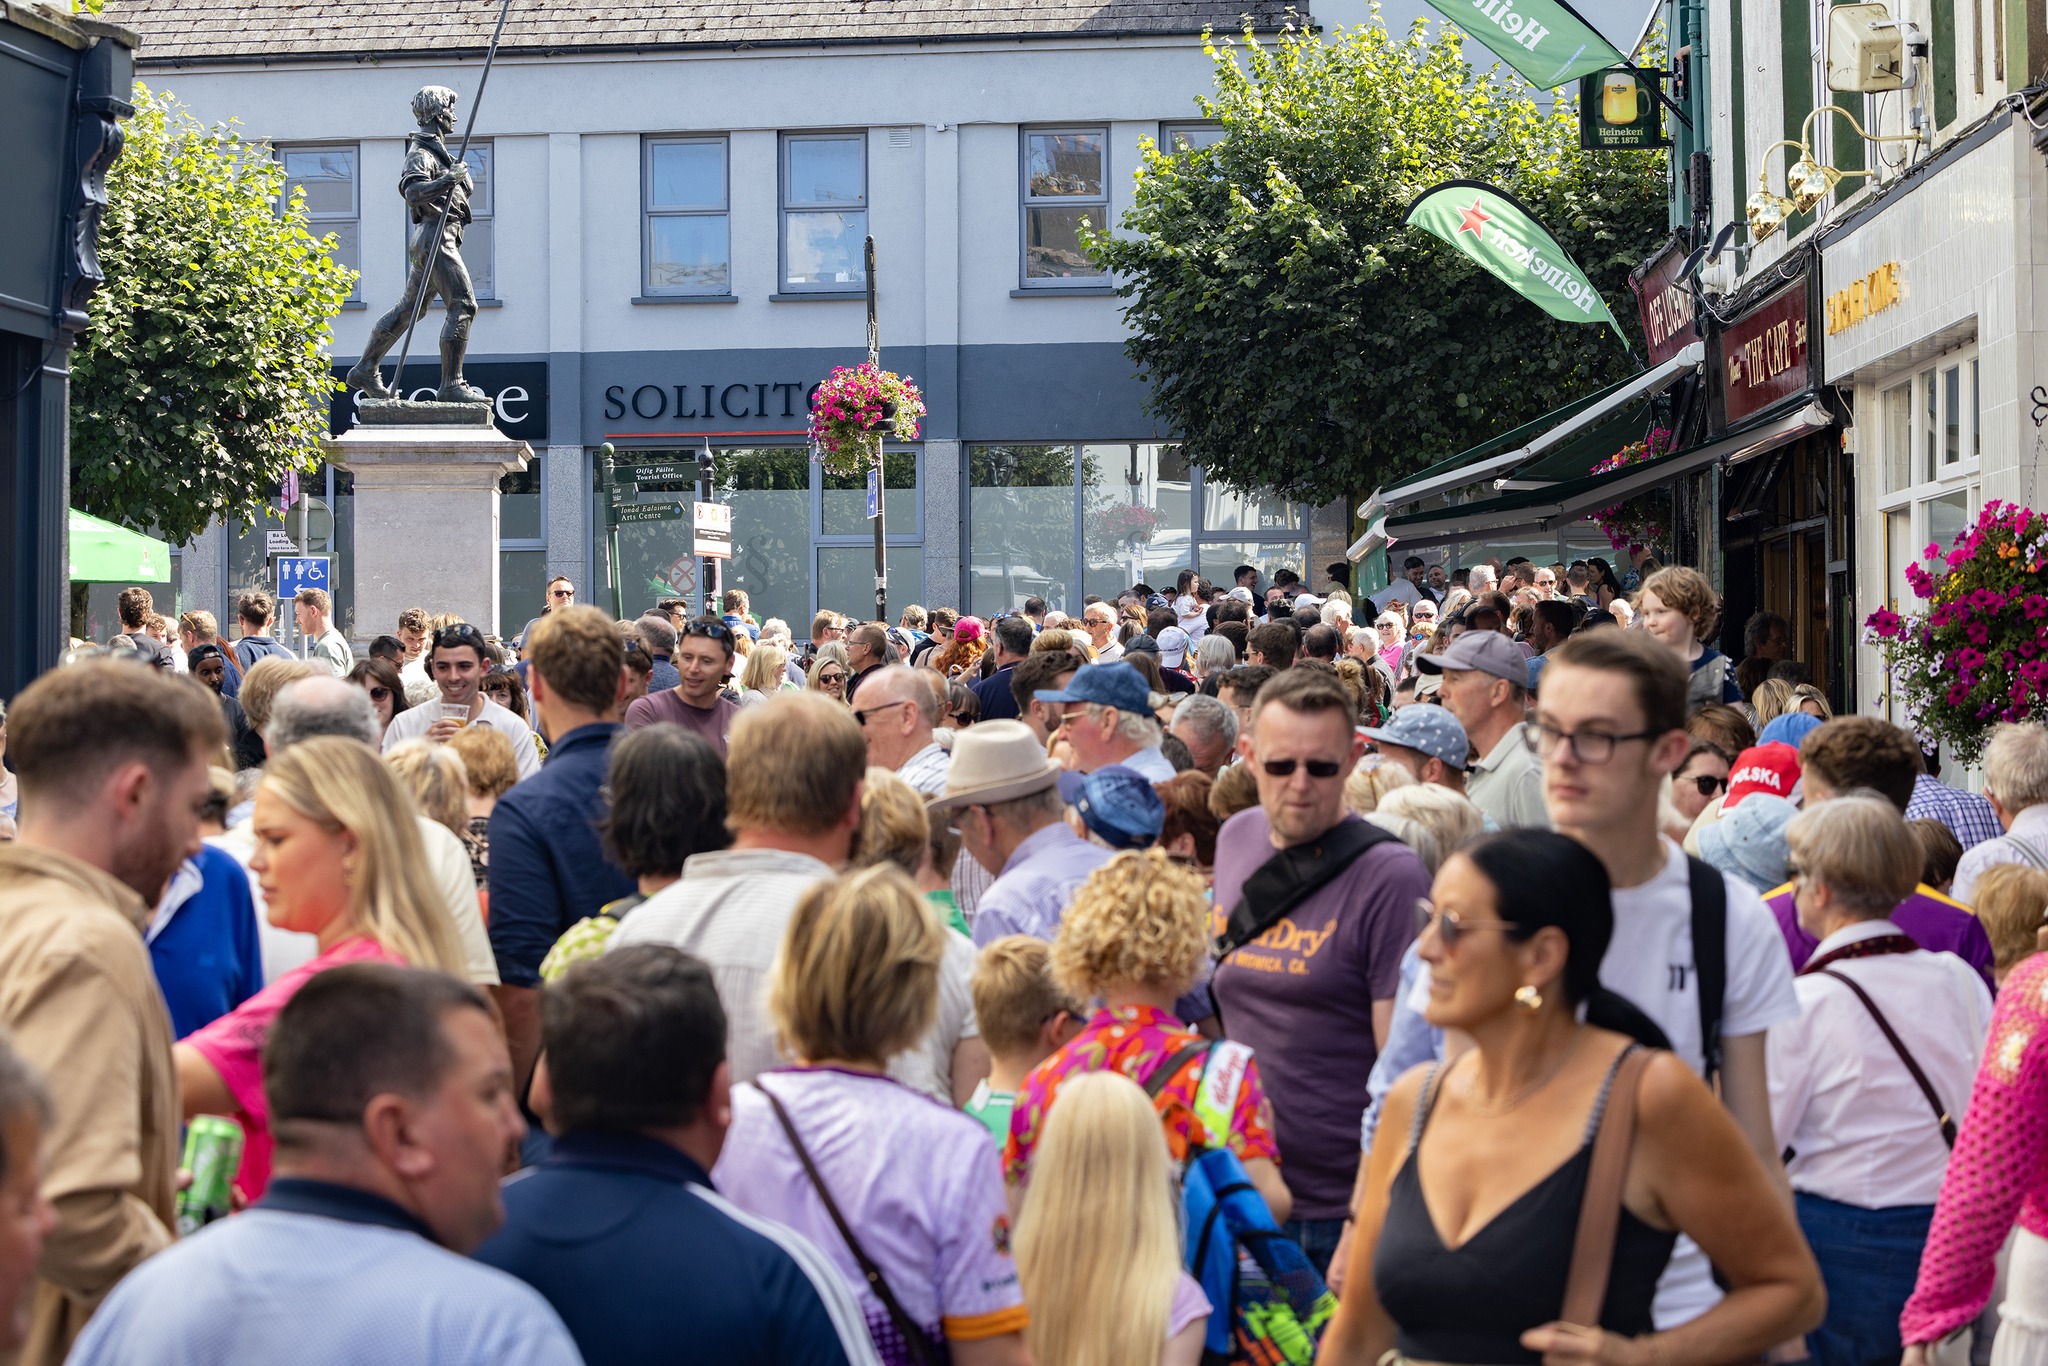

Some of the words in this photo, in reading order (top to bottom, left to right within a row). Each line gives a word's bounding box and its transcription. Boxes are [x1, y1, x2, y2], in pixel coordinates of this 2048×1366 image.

[1598, 127, 1644, 137] Heineken
[1603, 136, 1620, 144] EST.
[1621, 136, 1639, 144] 1873
[1649, 295, 1665, 347] OFF
[1744, 334, 1765, 388] THE
[1766, 318, 1790, 377] CAPE
[1730, 766, 1781, 790] POLSKA
